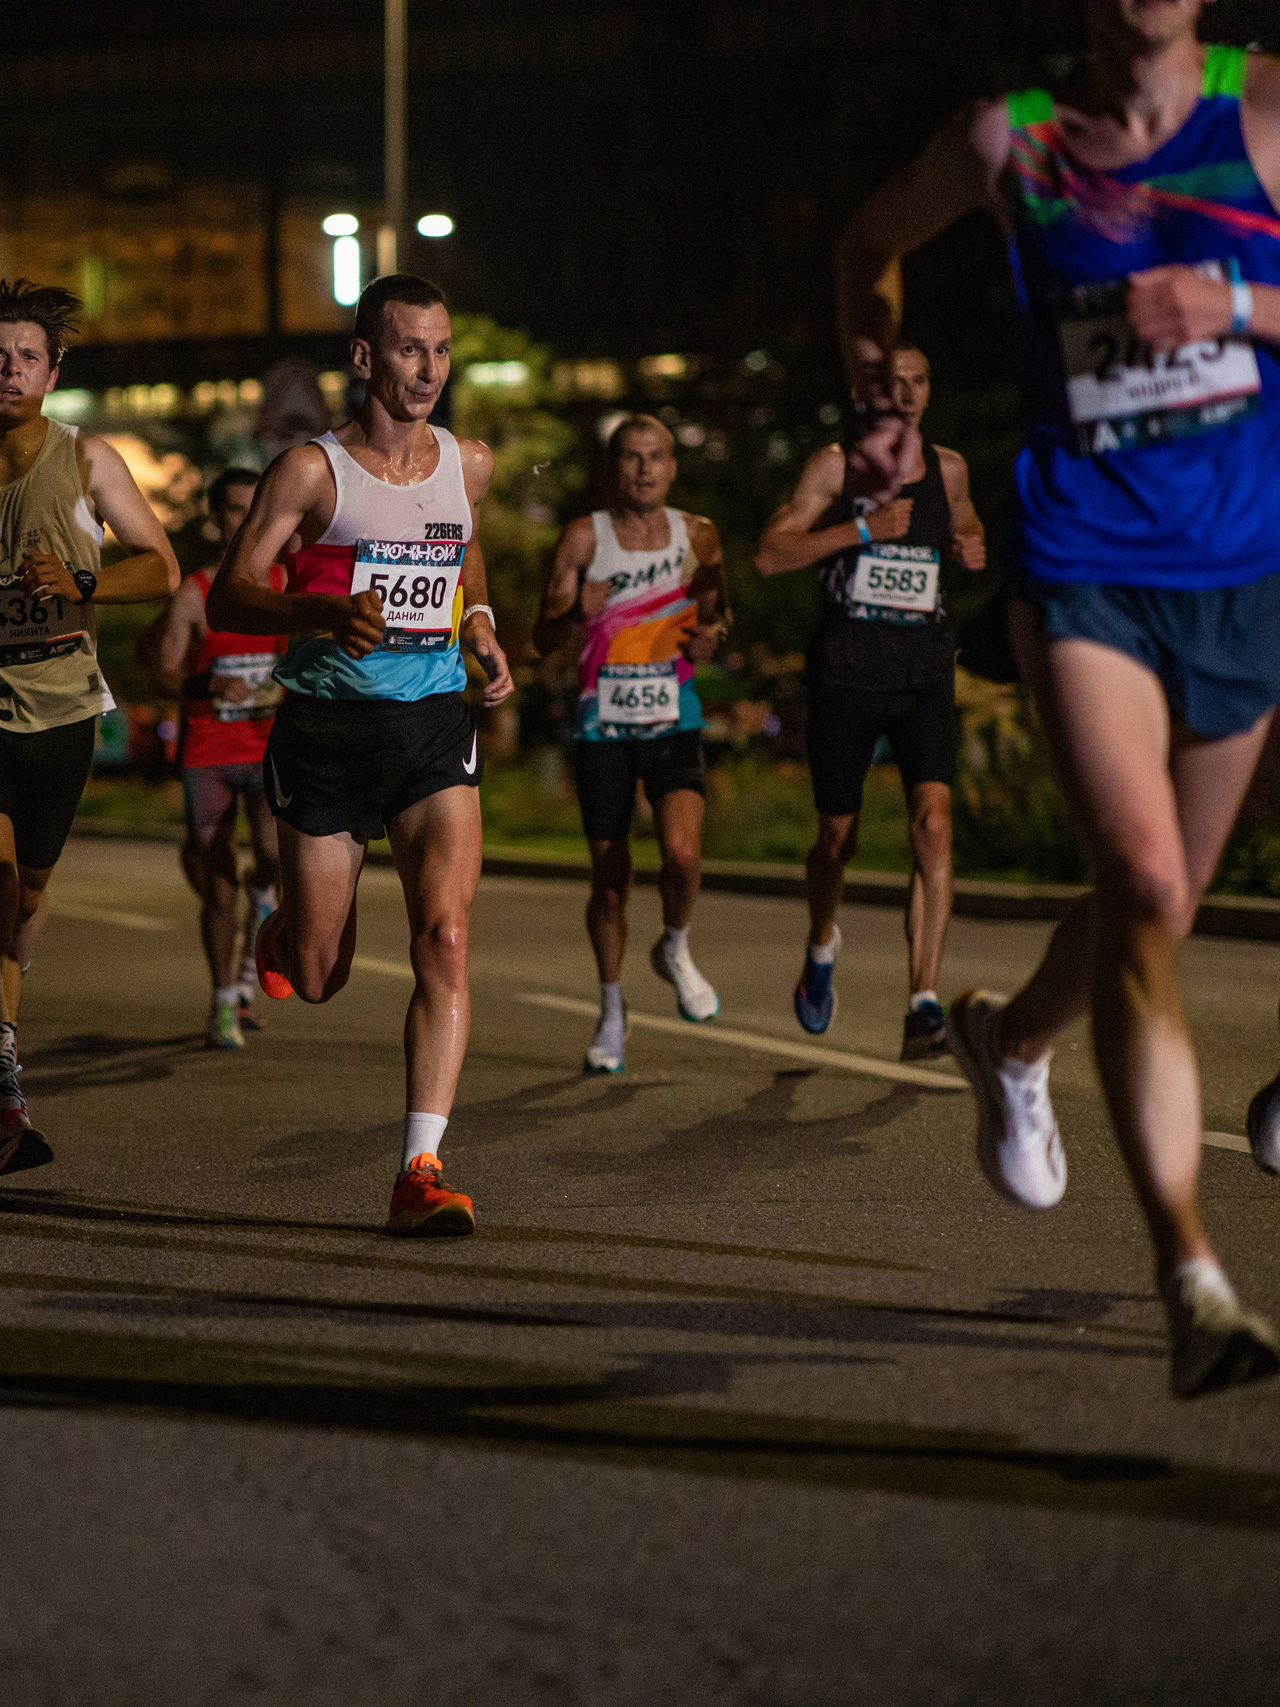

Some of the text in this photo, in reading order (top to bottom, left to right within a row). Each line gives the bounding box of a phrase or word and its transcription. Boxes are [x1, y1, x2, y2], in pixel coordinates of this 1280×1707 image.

[14, 529, 44, 543] OCKET
[424, 522, 463, 540] 226ERS
[18, 539, 41, 550] TEAM
[868, 567, 927, 593] 5583
[369, 573, 447, 609] 5680
[386, 611, 425, 622] ДАНИЛ
[9, 626, 51, 638] НИКИТА
[610, 683, 670, 708] 4656
